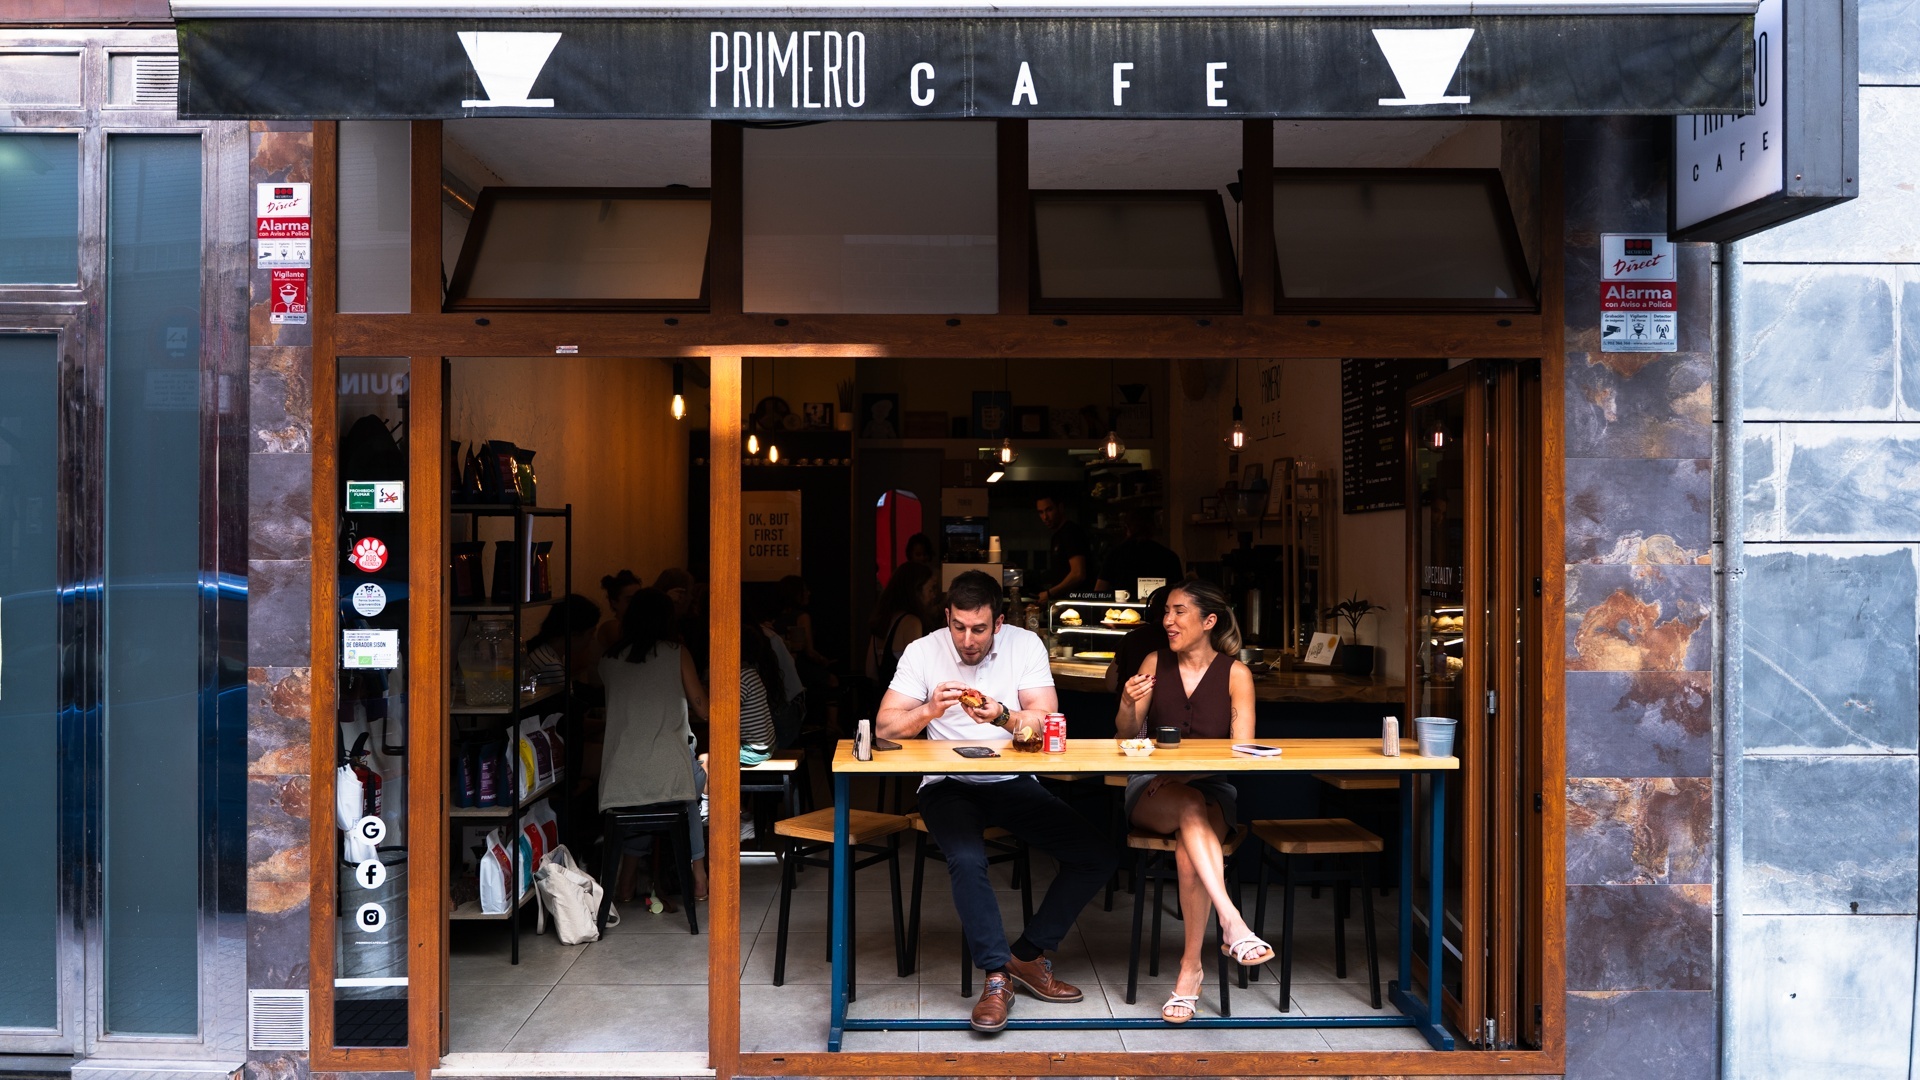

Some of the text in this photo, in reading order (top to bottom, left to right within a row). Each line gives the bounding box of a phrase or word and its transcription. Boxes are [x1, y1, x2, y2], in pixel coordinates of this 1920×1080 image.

[709, 31, 866, 109] PRIMERO
[259, 219, 309, 230] Alarma
[1613, 254, 1667, 276] Direct
[273, 271, 304, 279] Vigilante
[1605, 284, 1672, 299] Alarma
[1648, 300, 1672, 308] Policía
[749, 513, 789, 526] OK, BUT
[754, 528, 784, 541] FIRST
[749, 544, 789, 557] COFFEE
[1424, 566, 1453, 585] SPECIALTY
